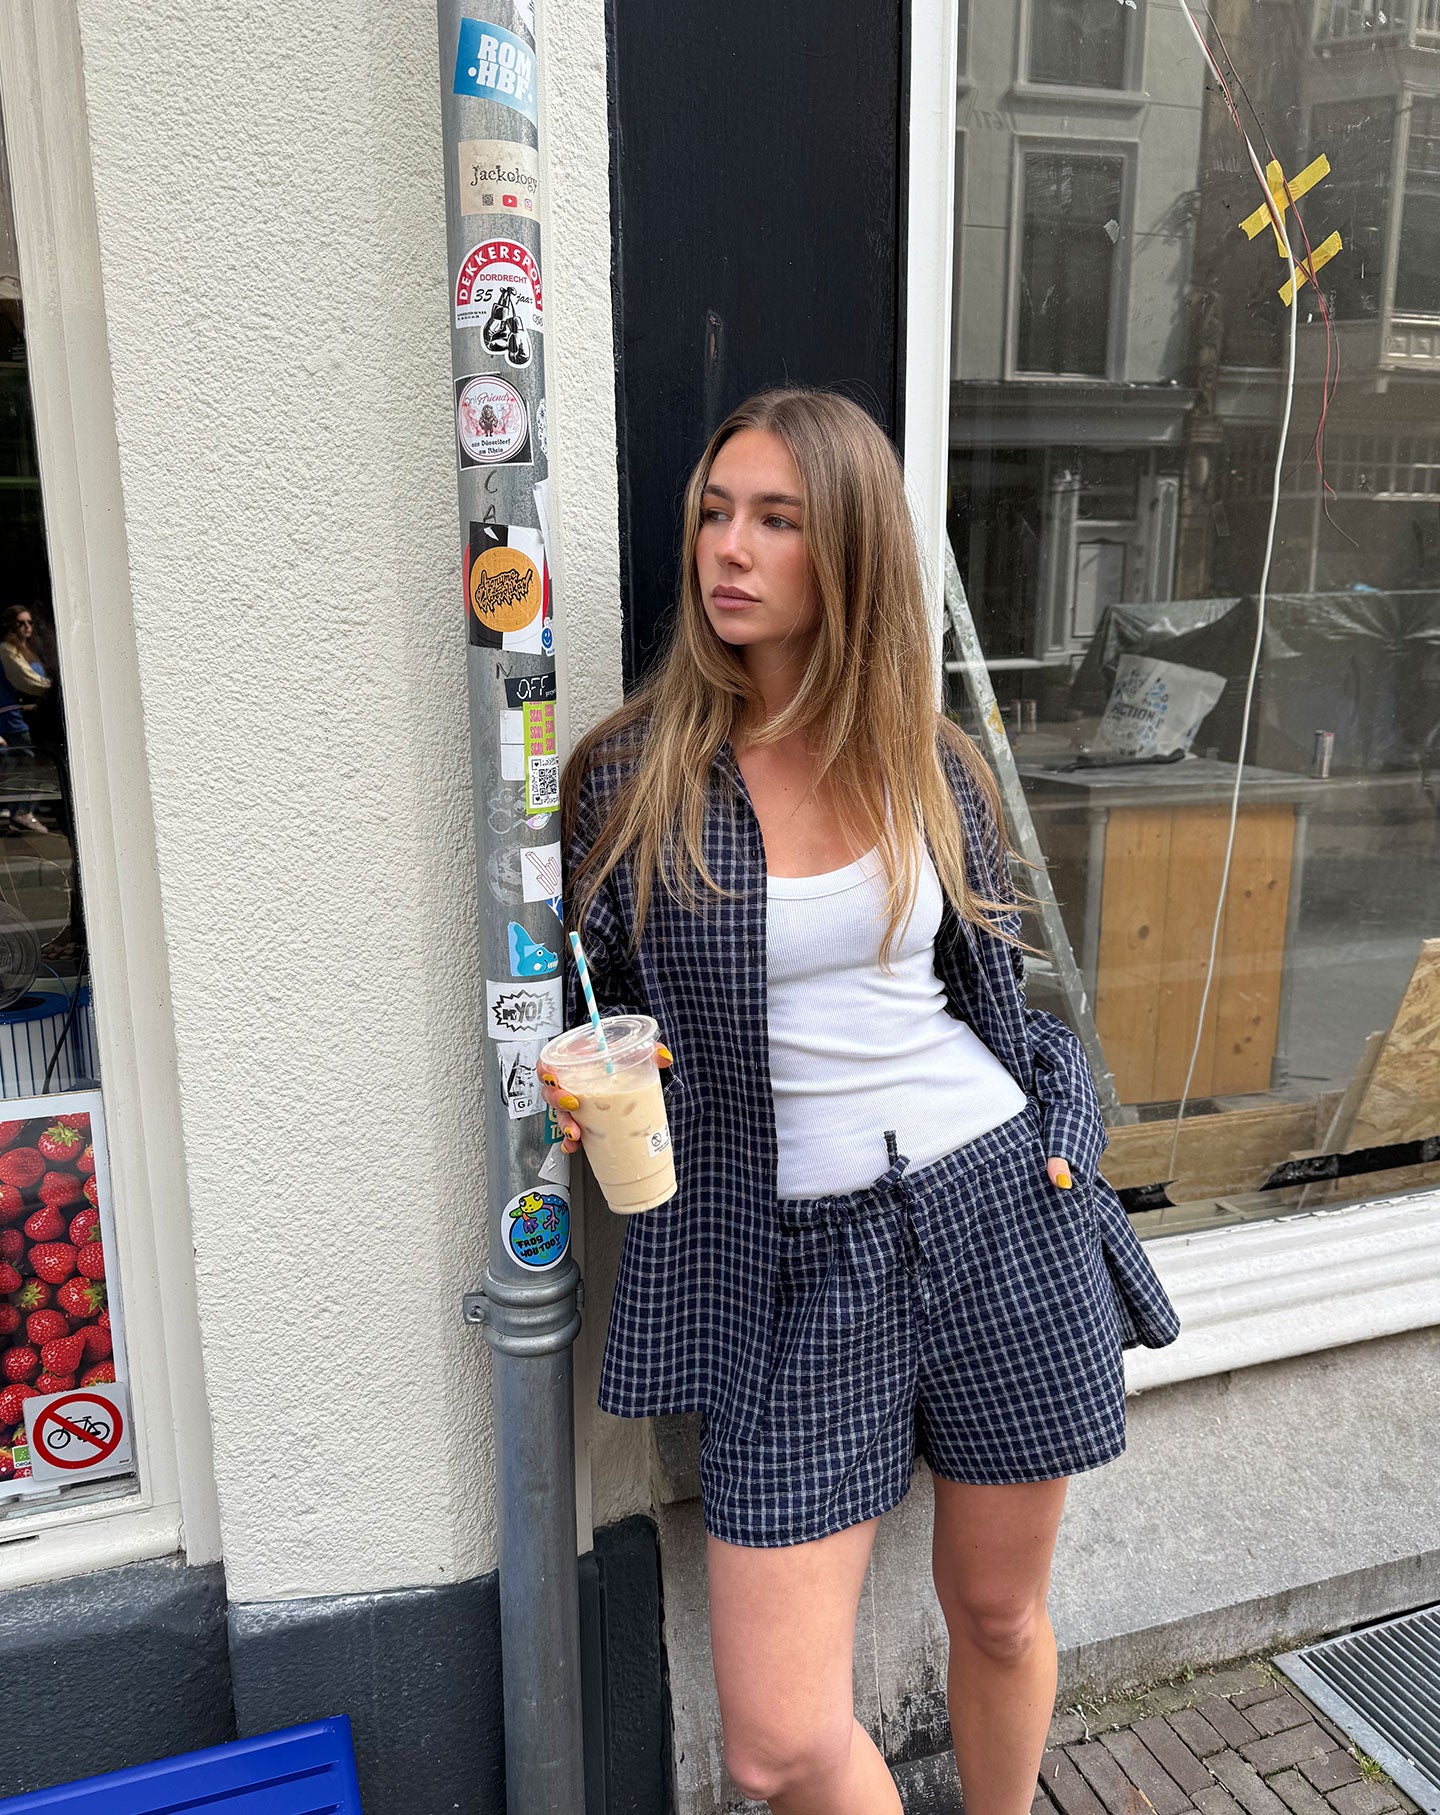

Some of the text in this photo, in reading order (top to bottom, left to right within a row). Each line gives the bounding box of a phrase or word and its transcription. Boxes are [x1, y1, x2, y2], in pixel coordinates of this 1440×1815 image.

[477, 34, 532, 82] ROM
[470, 164, 538, 194] Jackology
[479, 273, 528, 284] DORDRECHT
[473, 288, 494, 303] 35
[516, 675, 549, 699] OFF
[1111, 702, 1156, 722] ACTION
[515, 1235, 544, 1249] FROG
